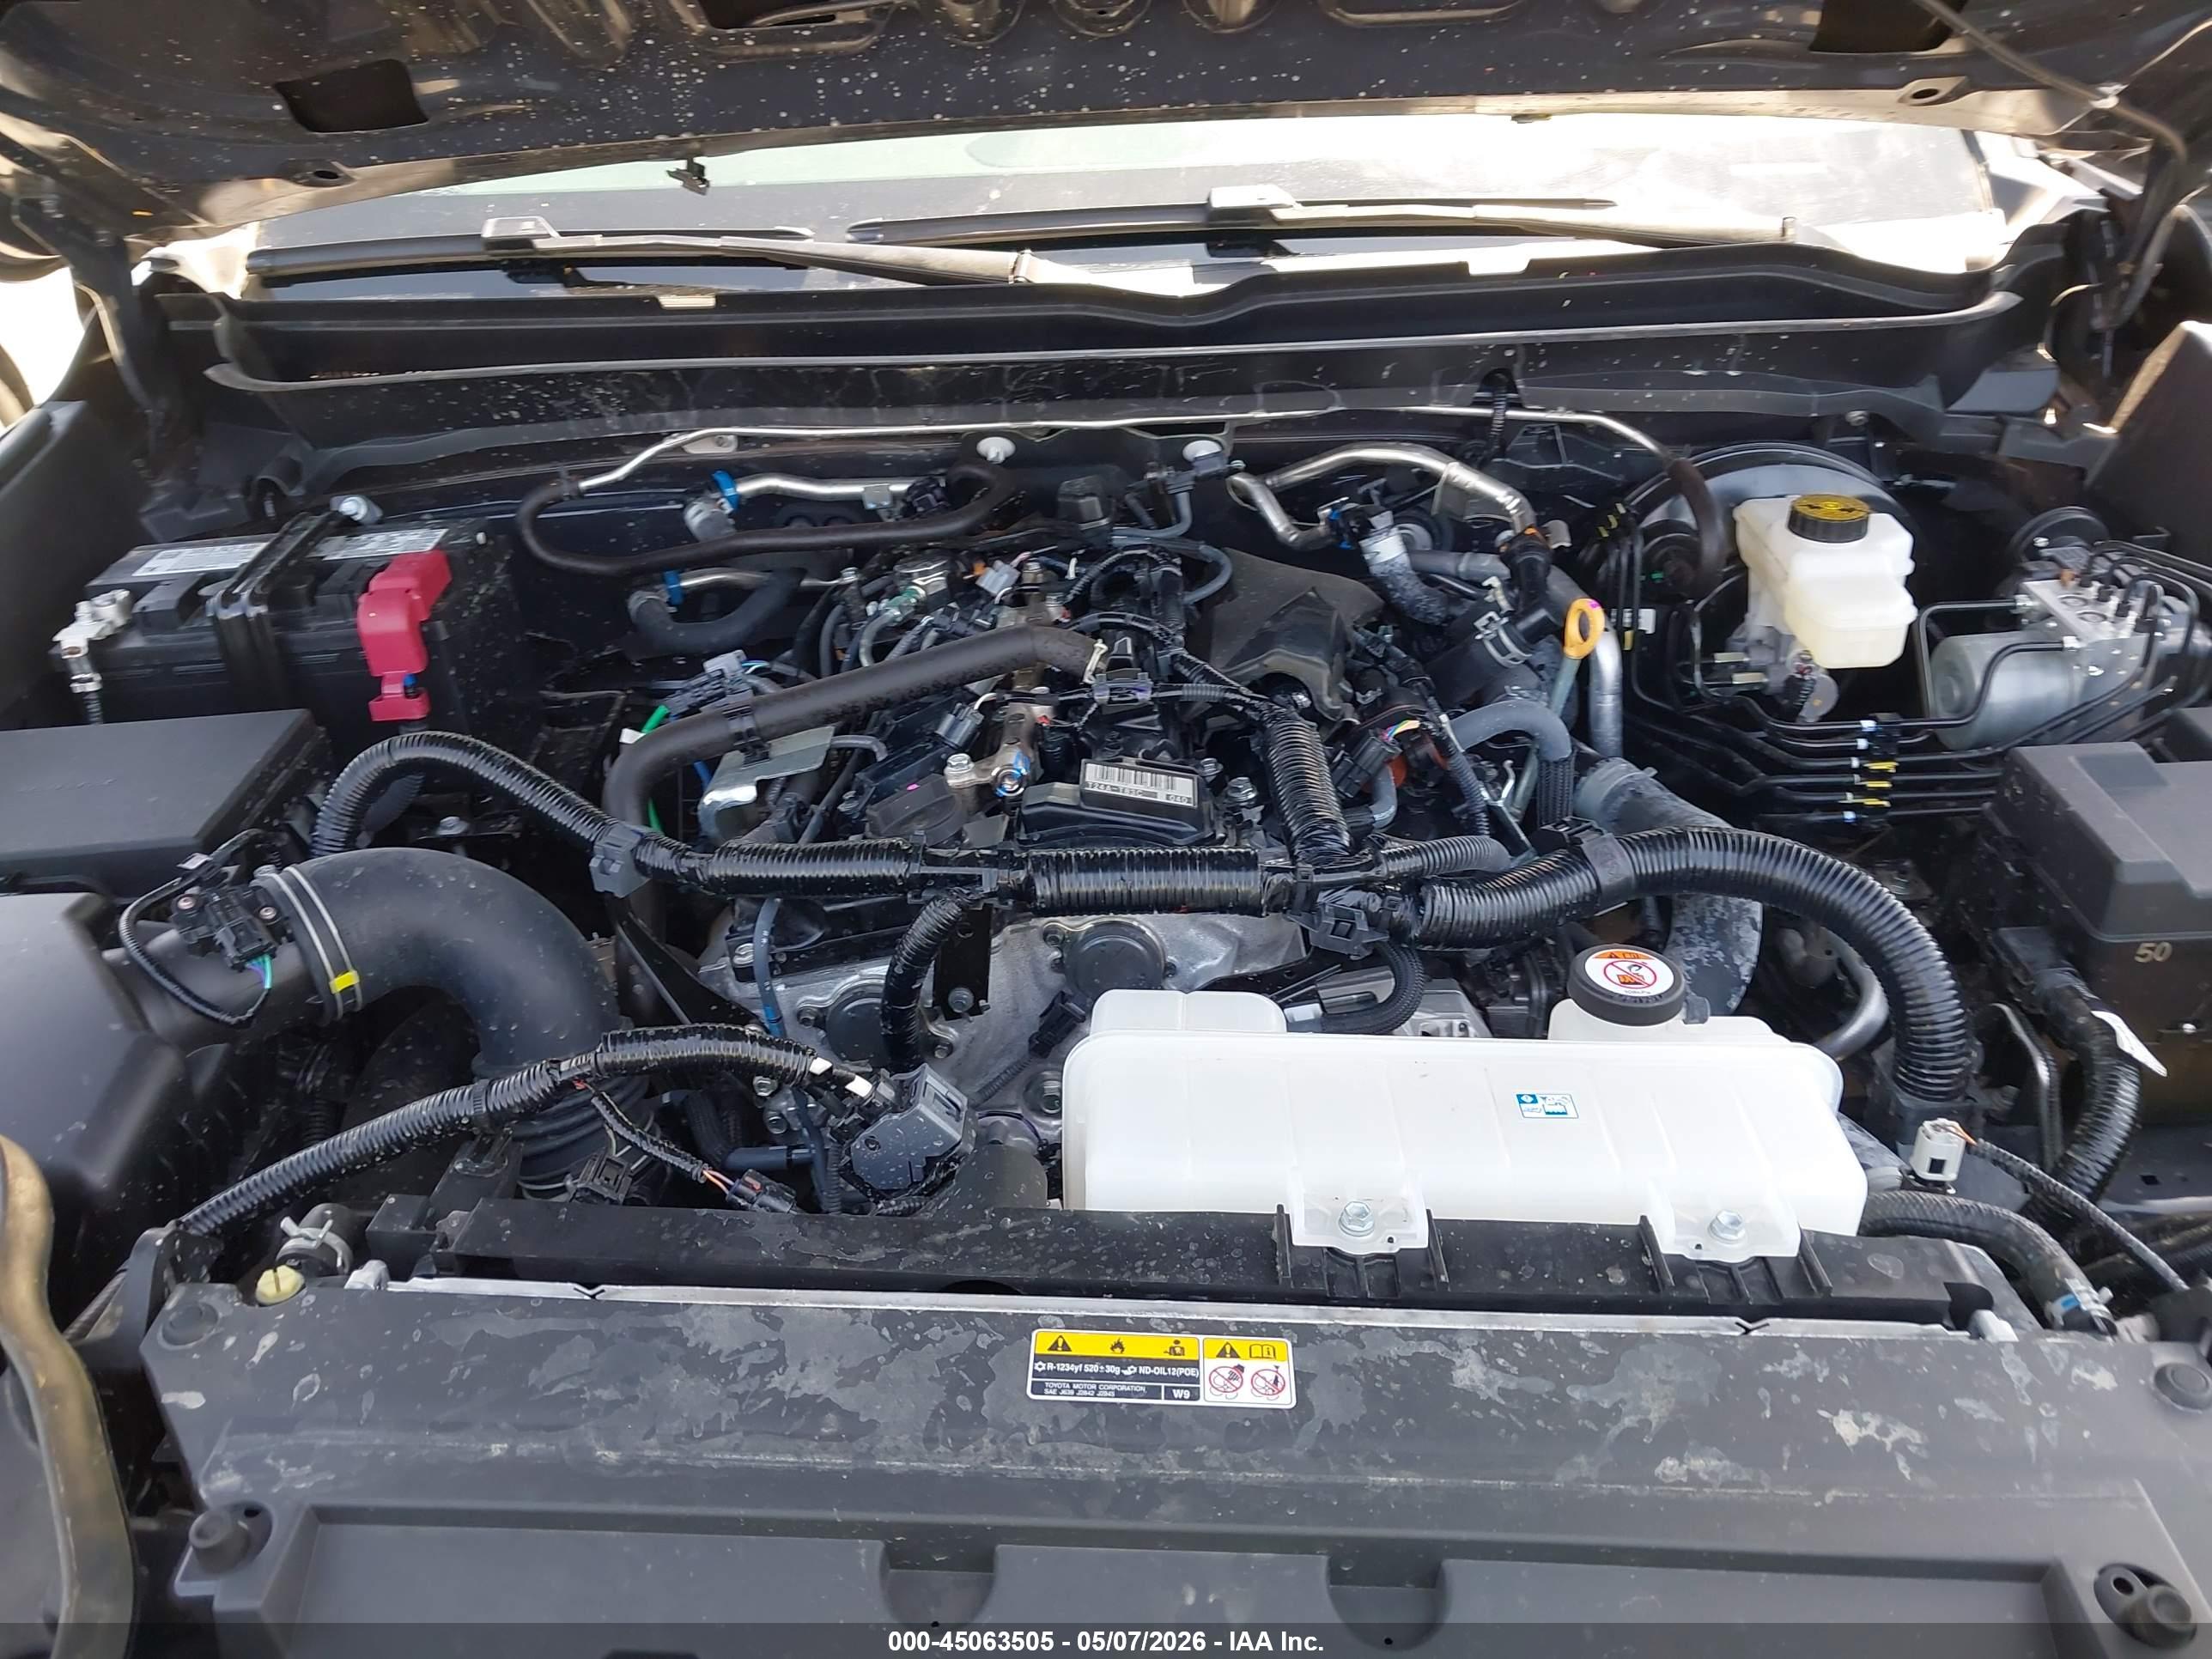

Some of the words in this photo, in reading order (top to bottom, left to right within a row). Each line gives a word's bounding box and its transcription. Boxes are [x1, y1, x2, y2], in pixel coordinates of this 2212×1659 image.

[2134, 941, 2172, 963] 50
[1047, 1362, 1083, 1374] R-1234yf
[1084, 1364, 1121, 1376] 520±30g
[1139, 1366, 1200, 1378] ND-OIL12(POE)
[1172, 1389, 1191, 1400] W9
